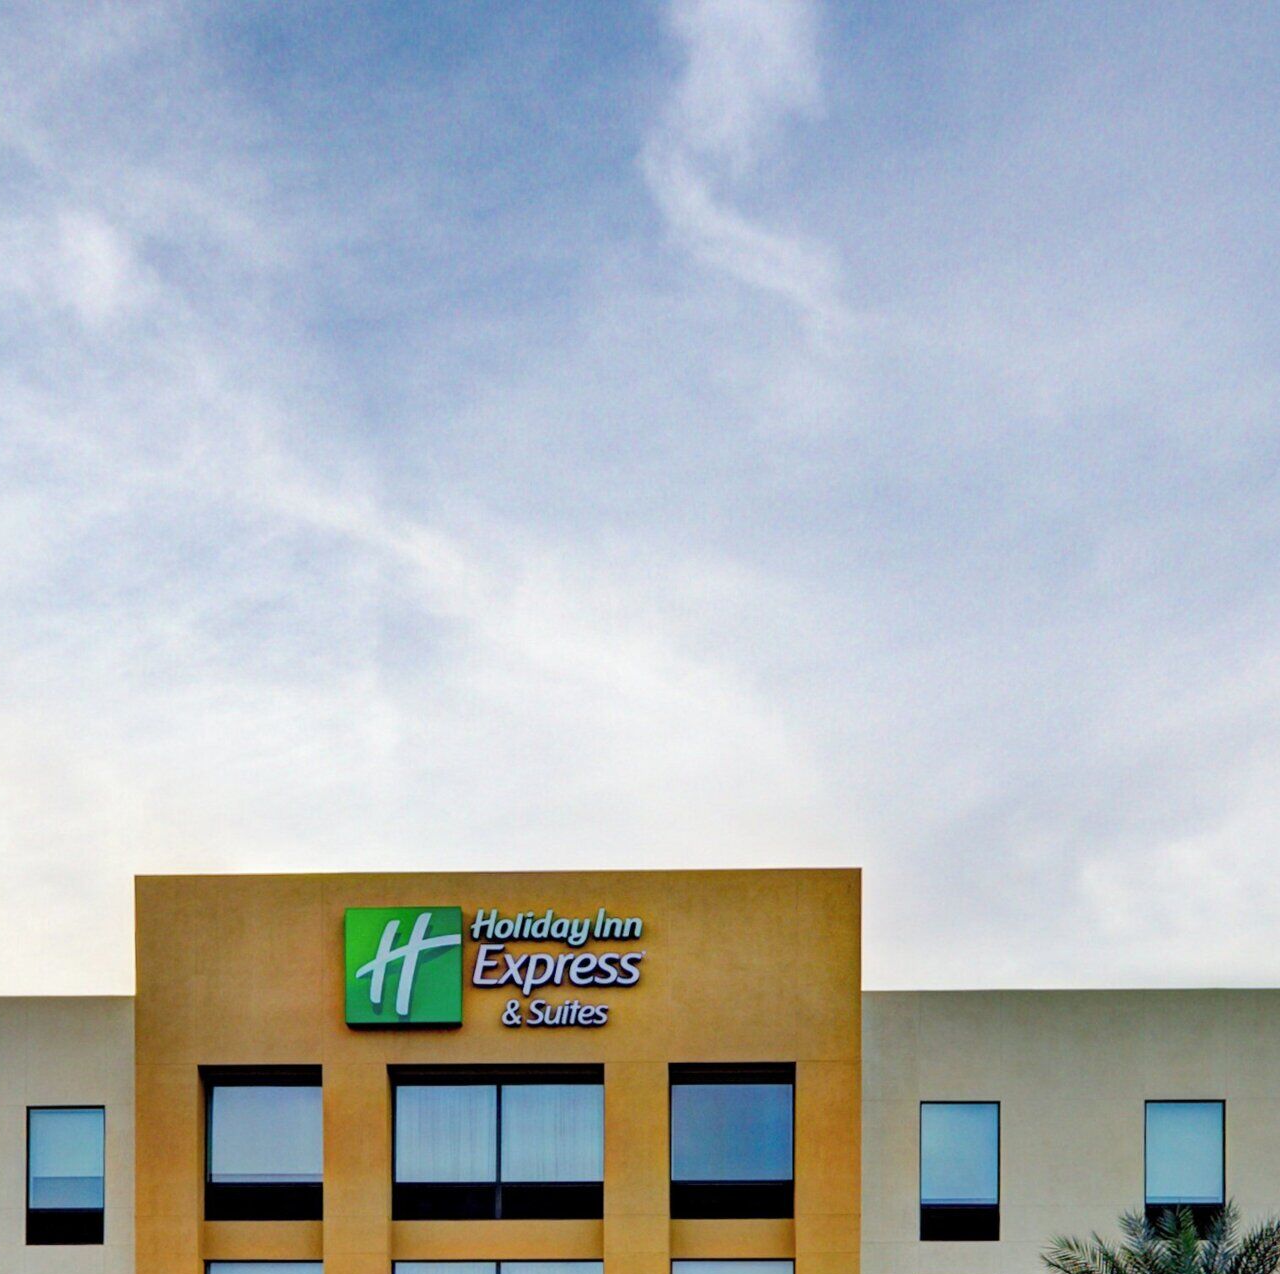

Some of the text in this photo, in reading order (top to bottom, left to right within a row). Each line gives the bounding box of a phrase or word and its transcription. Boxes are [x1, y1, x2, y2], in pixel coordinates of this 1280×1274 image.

[470, 907, 643, 946] Holiday Inn
[472, 943, 642, 997] Express
[501, 999, 609, 1026] & Suites
